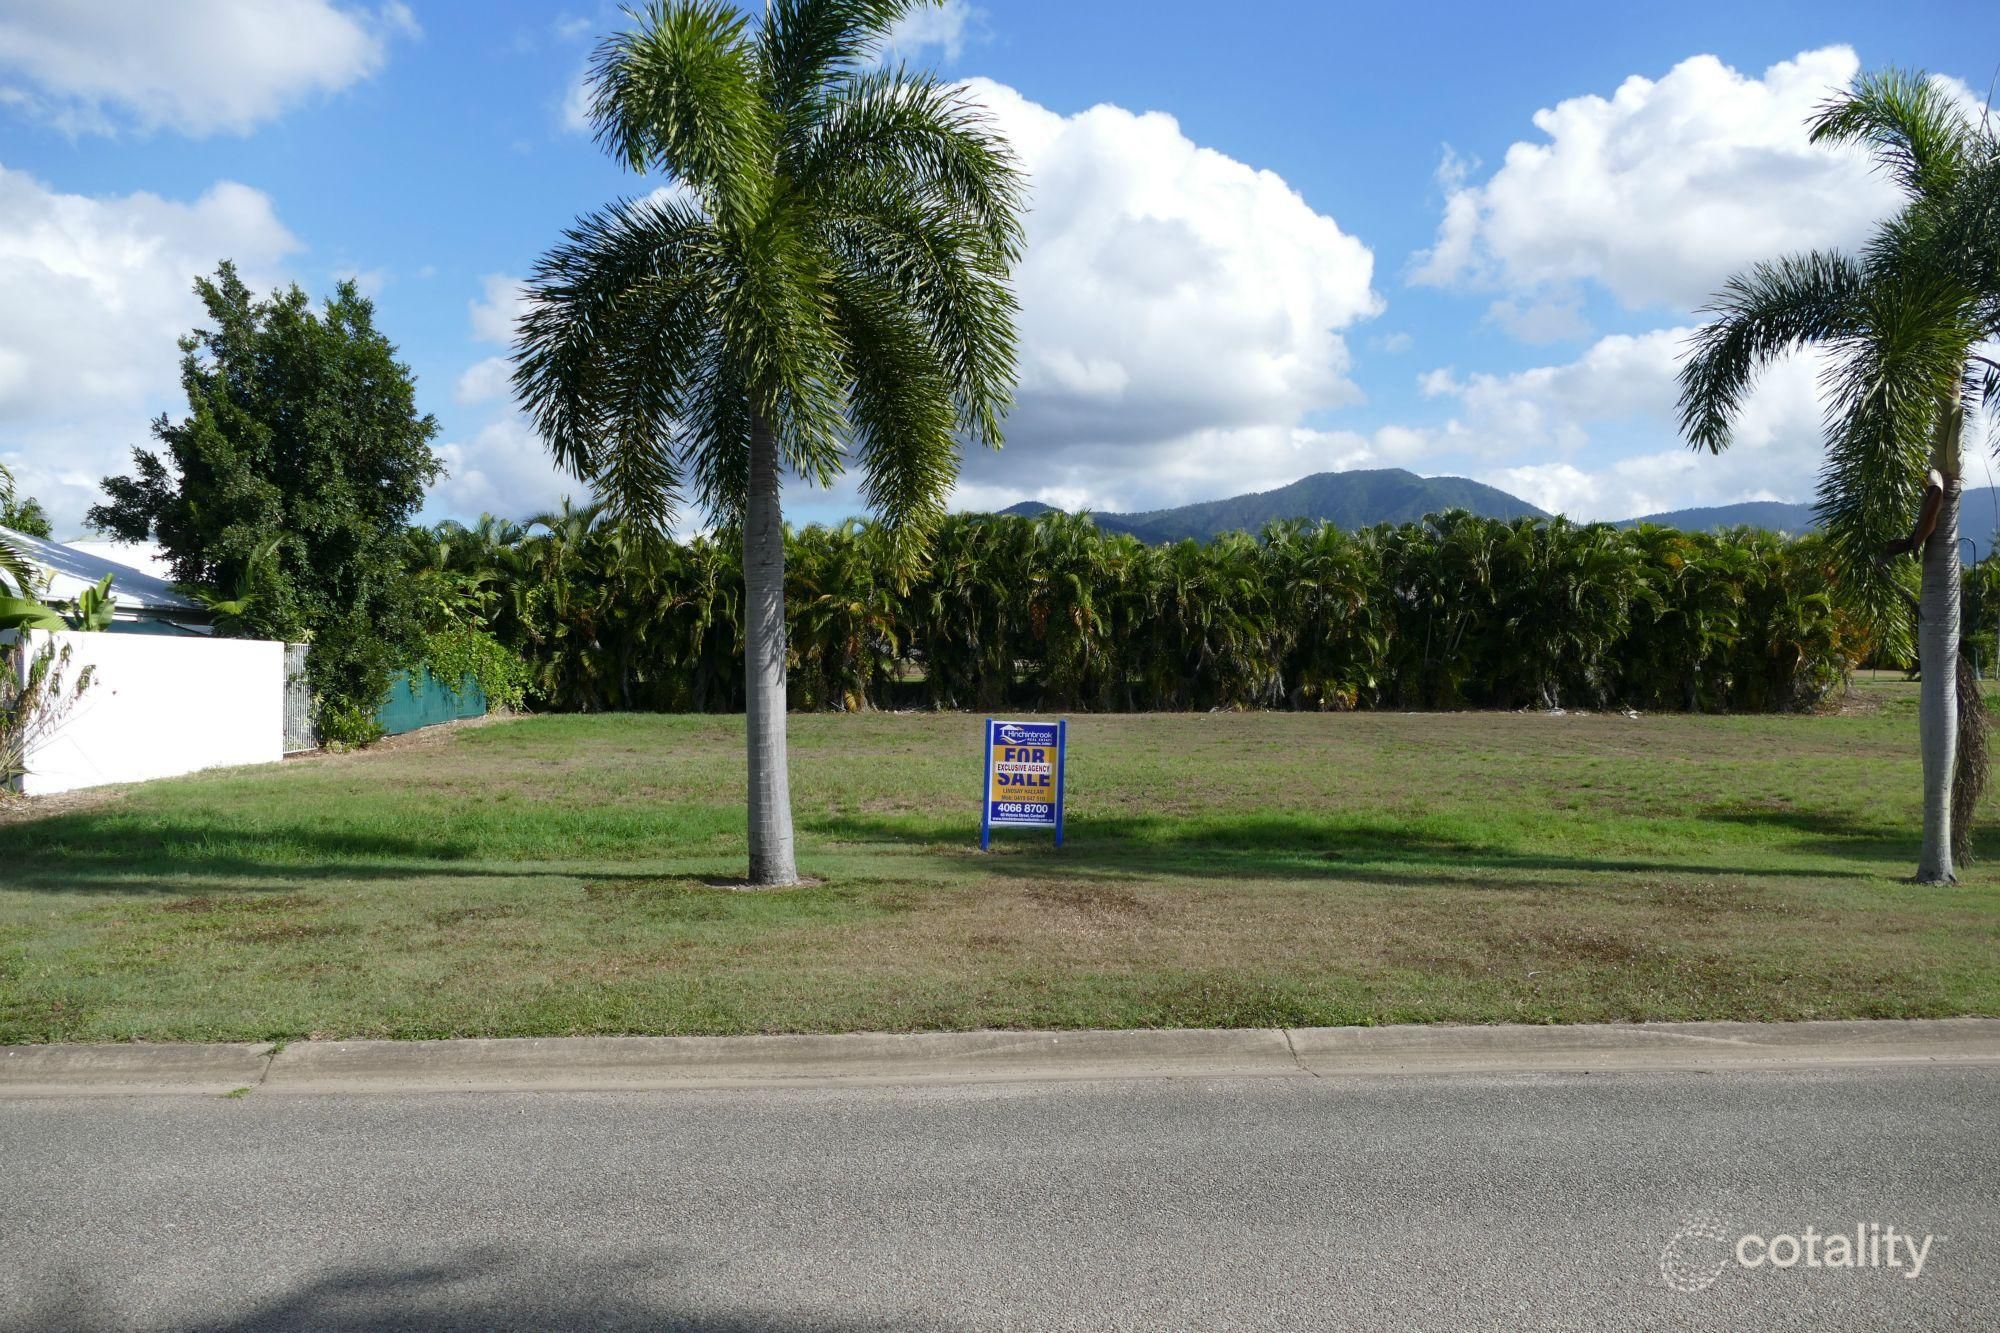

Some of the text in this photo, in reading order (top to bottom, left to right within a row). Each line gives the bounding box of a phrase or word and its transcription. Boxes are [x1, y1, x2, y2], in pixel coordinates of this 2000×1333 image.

[1008, 731, 1053, 739] Hinchinbrook
[1005, 747, 1045, 763] FOR
[997, 763, 1050, 773] EXCLUSIVE AGENCY
[997, 772, 1050, 786] SALE
[997, 803, 1048, 814] 4066 8700
